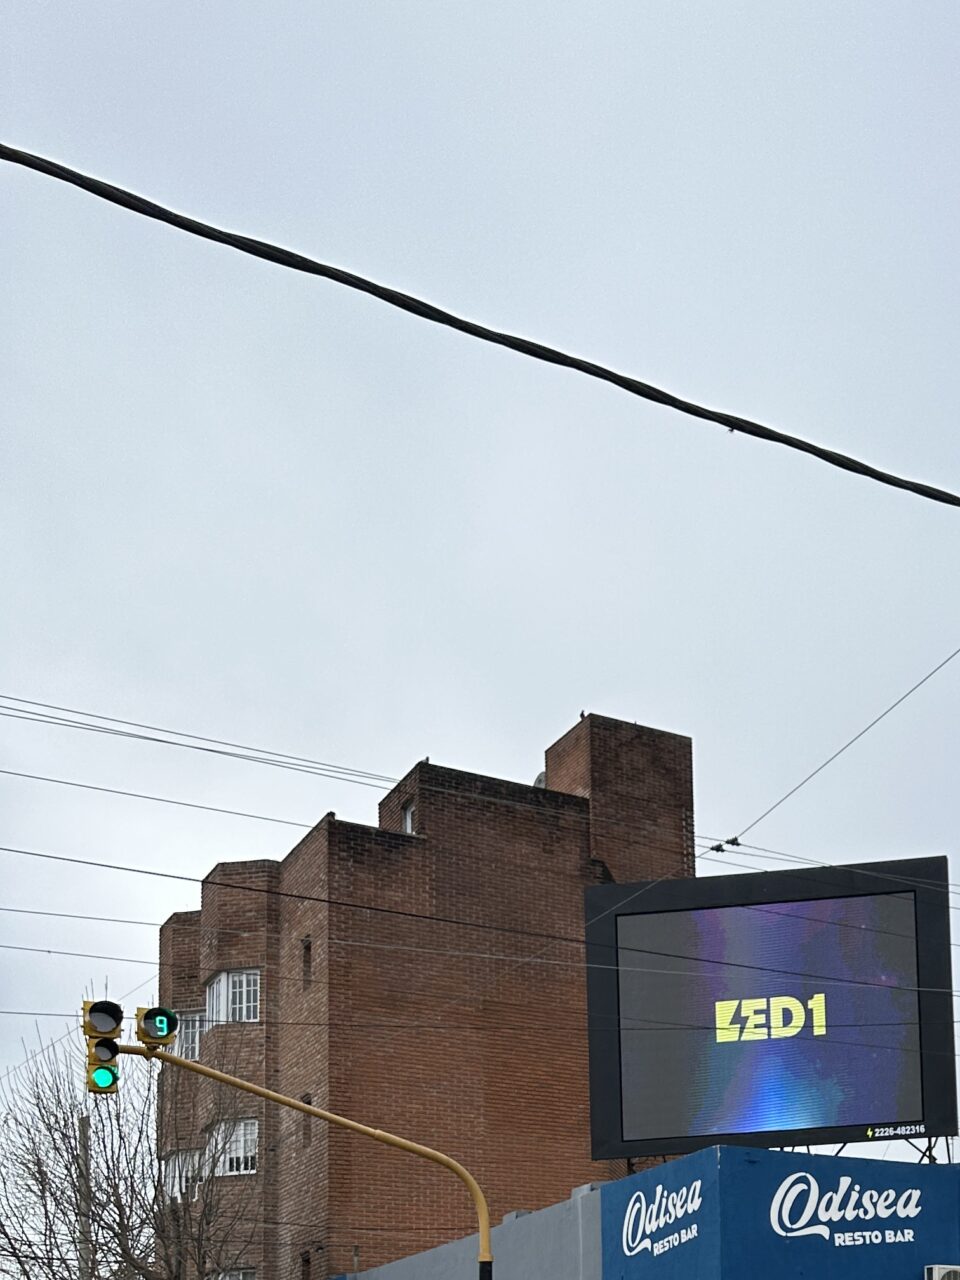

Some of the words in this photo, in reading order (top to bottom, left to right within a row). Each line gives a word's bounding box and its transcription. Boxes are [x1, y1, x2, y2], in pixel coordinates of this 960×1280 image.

[155, 1016, 168, 1036] 9
[874, 1125, 926, 1137] 2226-482316
[622, 1179, 702, 1256] Odisea
[770, 1172, 922, 1241] Odisea
[653, 1232, 680, 1257] RESTO
[680, 1223, 698, 1244] BAR
[834, 1230, 882, 1247] RESTO
[885, 1229, 915, 1244] BAR
